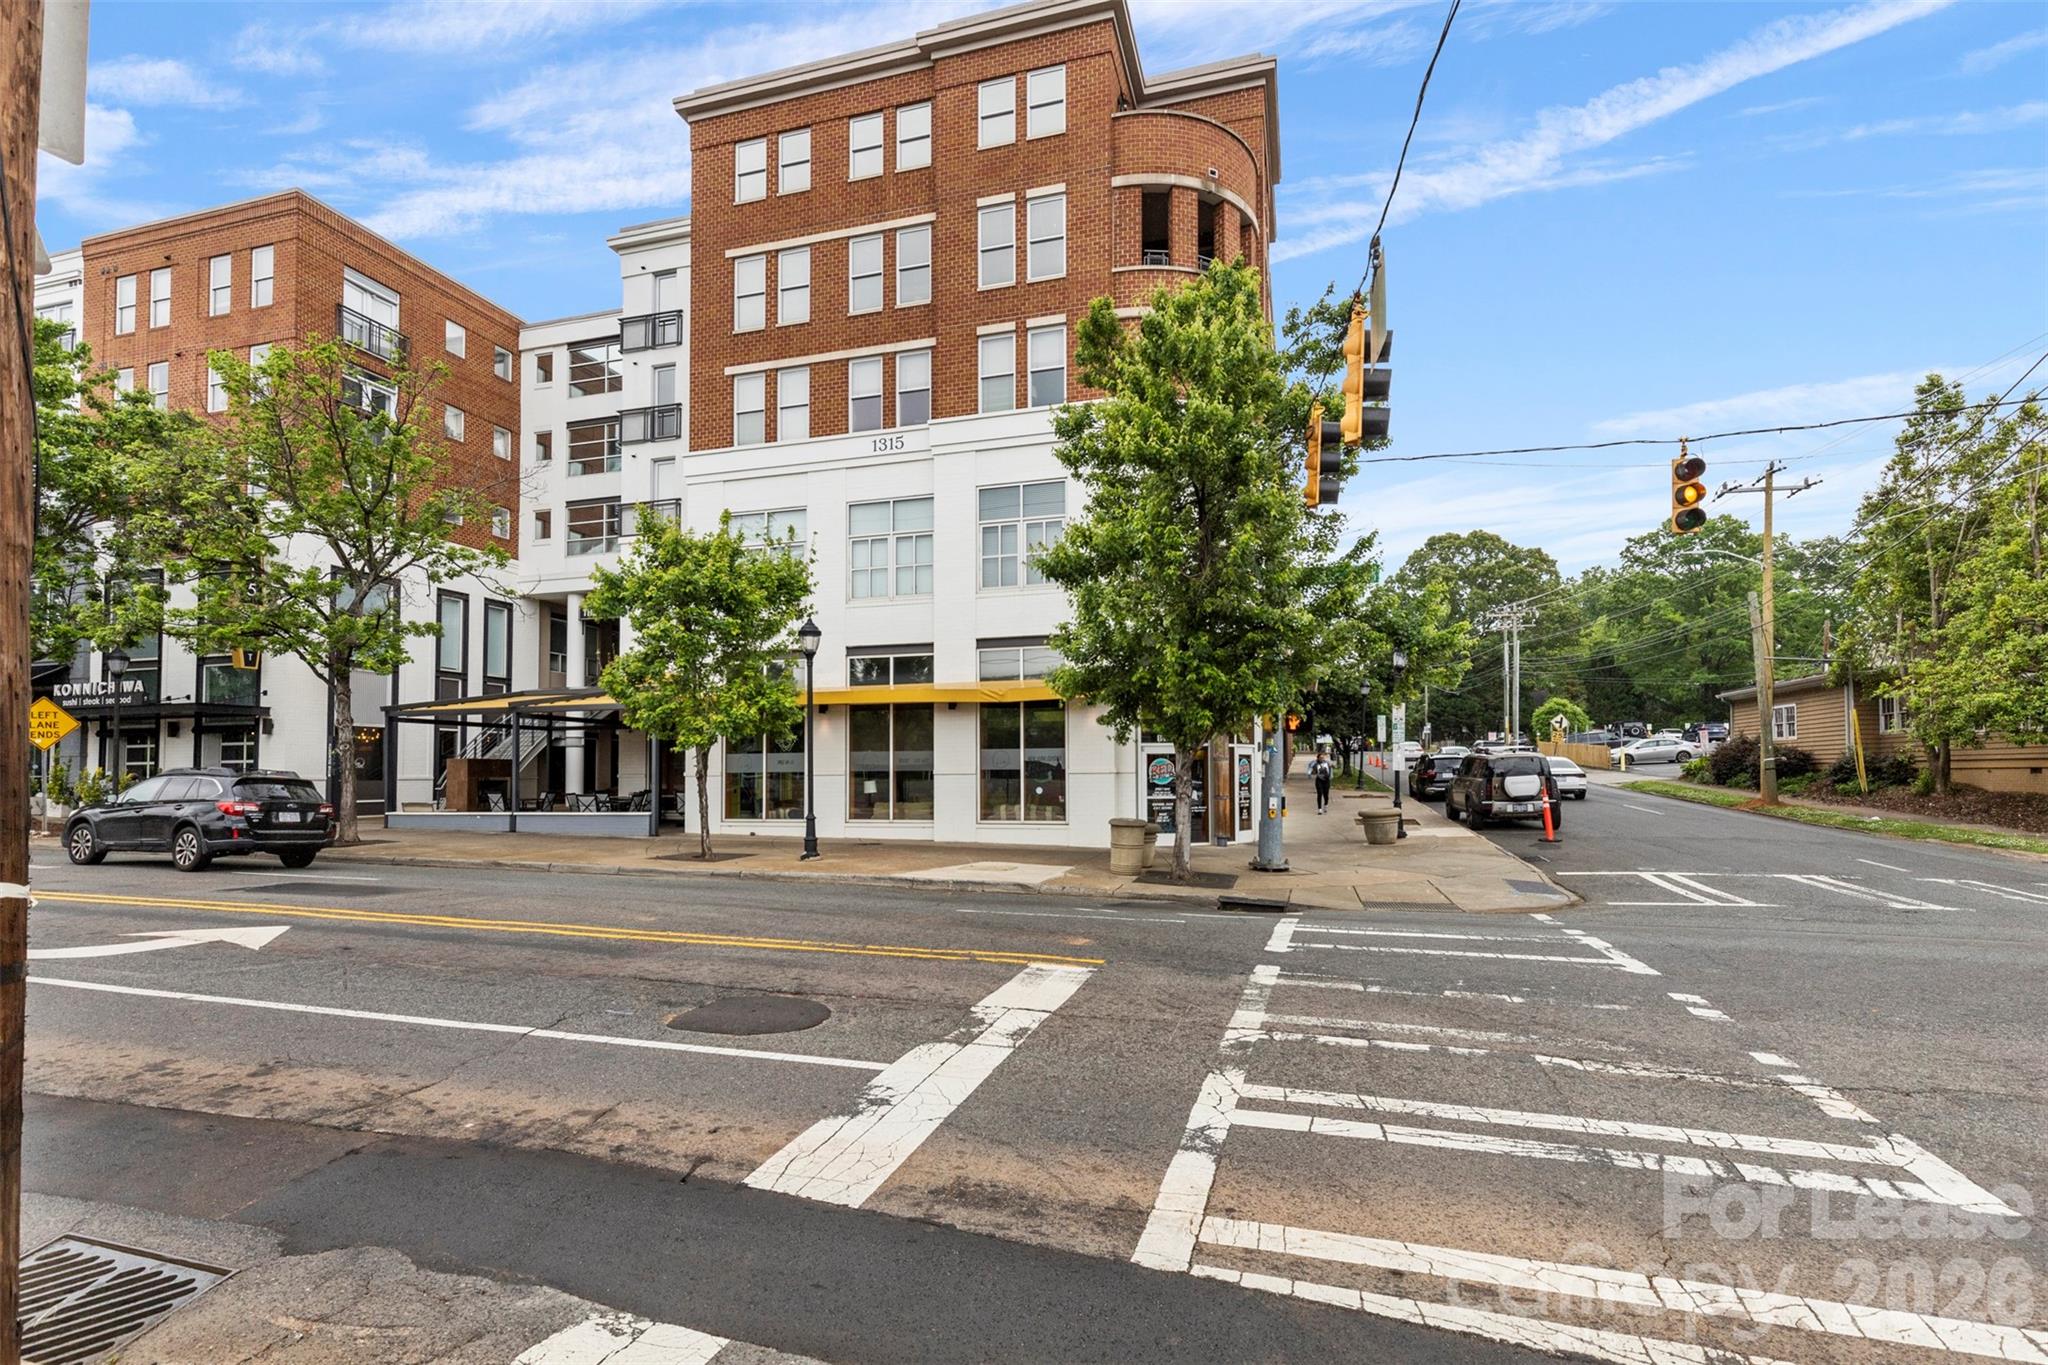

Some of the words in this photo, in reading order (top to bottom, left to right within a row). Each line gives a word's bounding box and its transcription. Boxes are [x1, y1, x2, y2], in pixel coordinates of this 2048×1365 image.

[872, 435, 905, 452] 1315
[62, 698, 78, 706] sushi
[83, 697, 100, 706] steak
[31, 711, 58, 719] LEFT
[29, 721, 60, 729] LANE
[30, 731, 61, 739] ENDS
